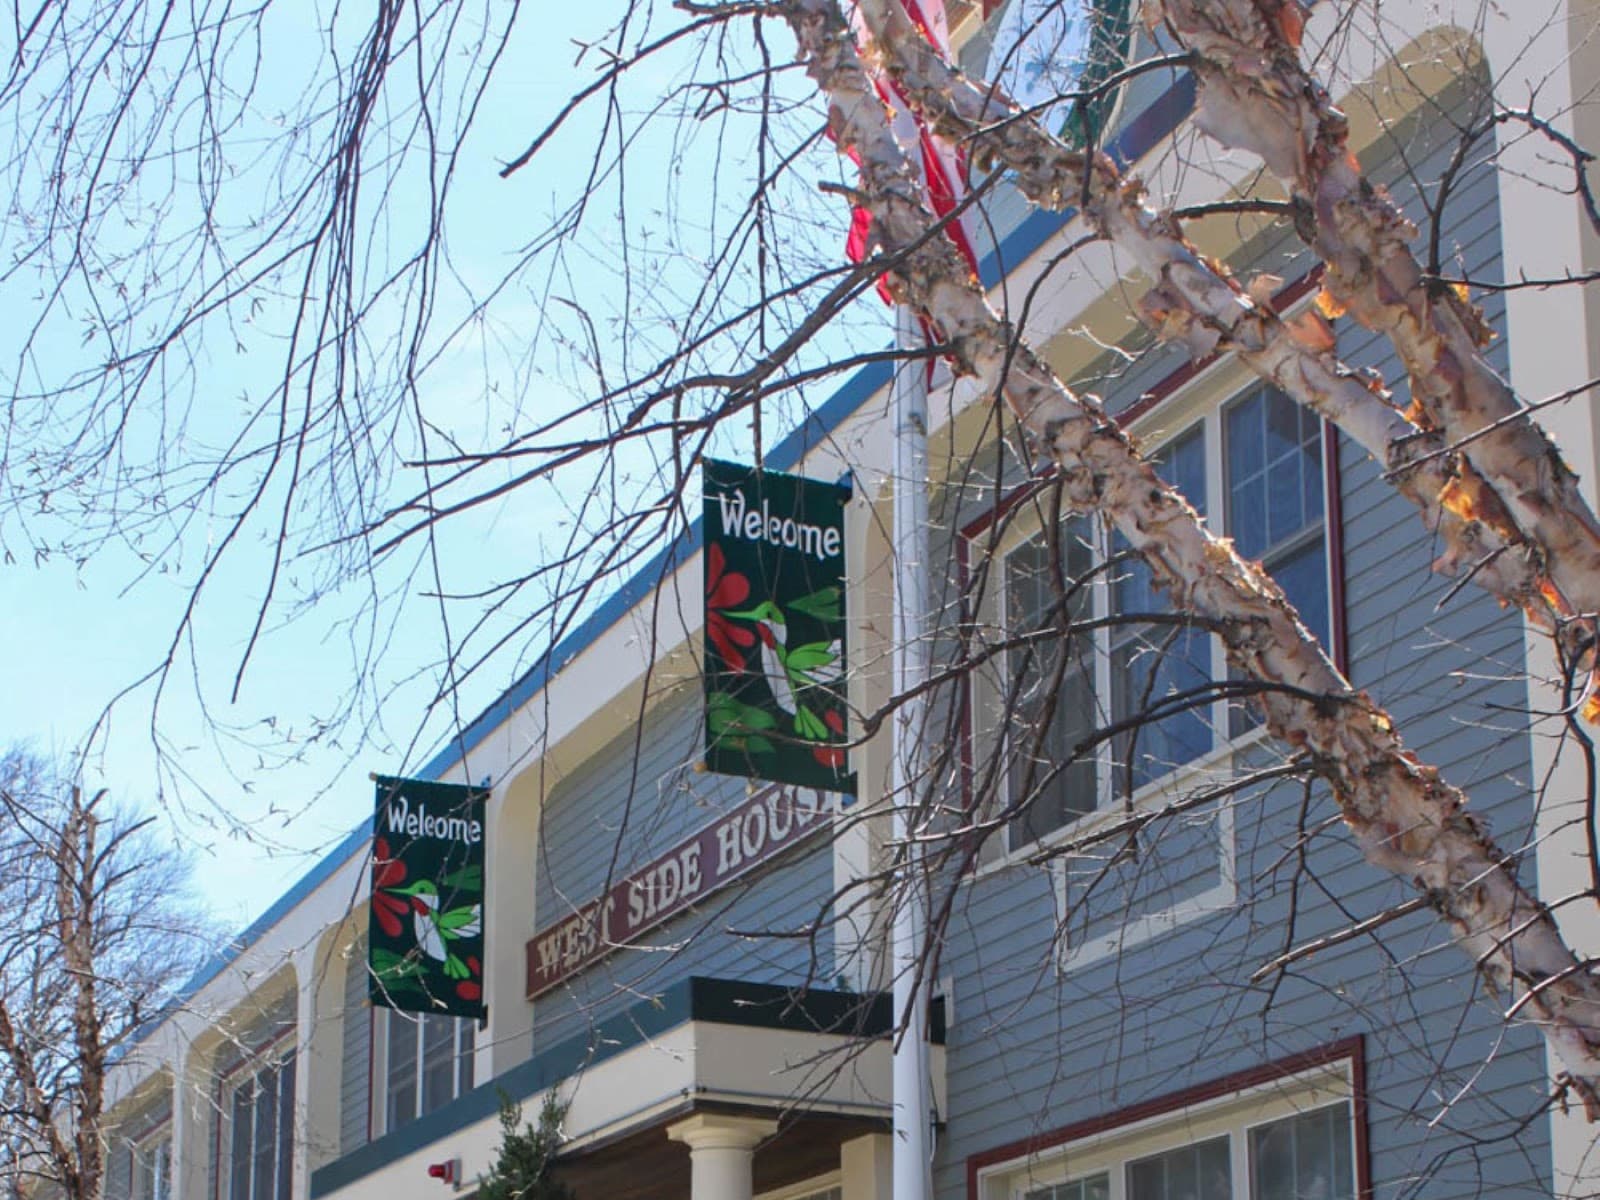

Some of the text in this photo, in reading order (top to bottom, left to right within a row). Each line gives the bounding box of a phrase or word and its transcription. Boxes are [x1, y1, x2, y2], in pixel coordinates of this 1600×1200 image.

[719, 488, 841, 560] Welcome
[387, 796, 482, 845] Welcome
[537, 896, 616, 980] WEST
[627, 842, 702, 929] SIDE
